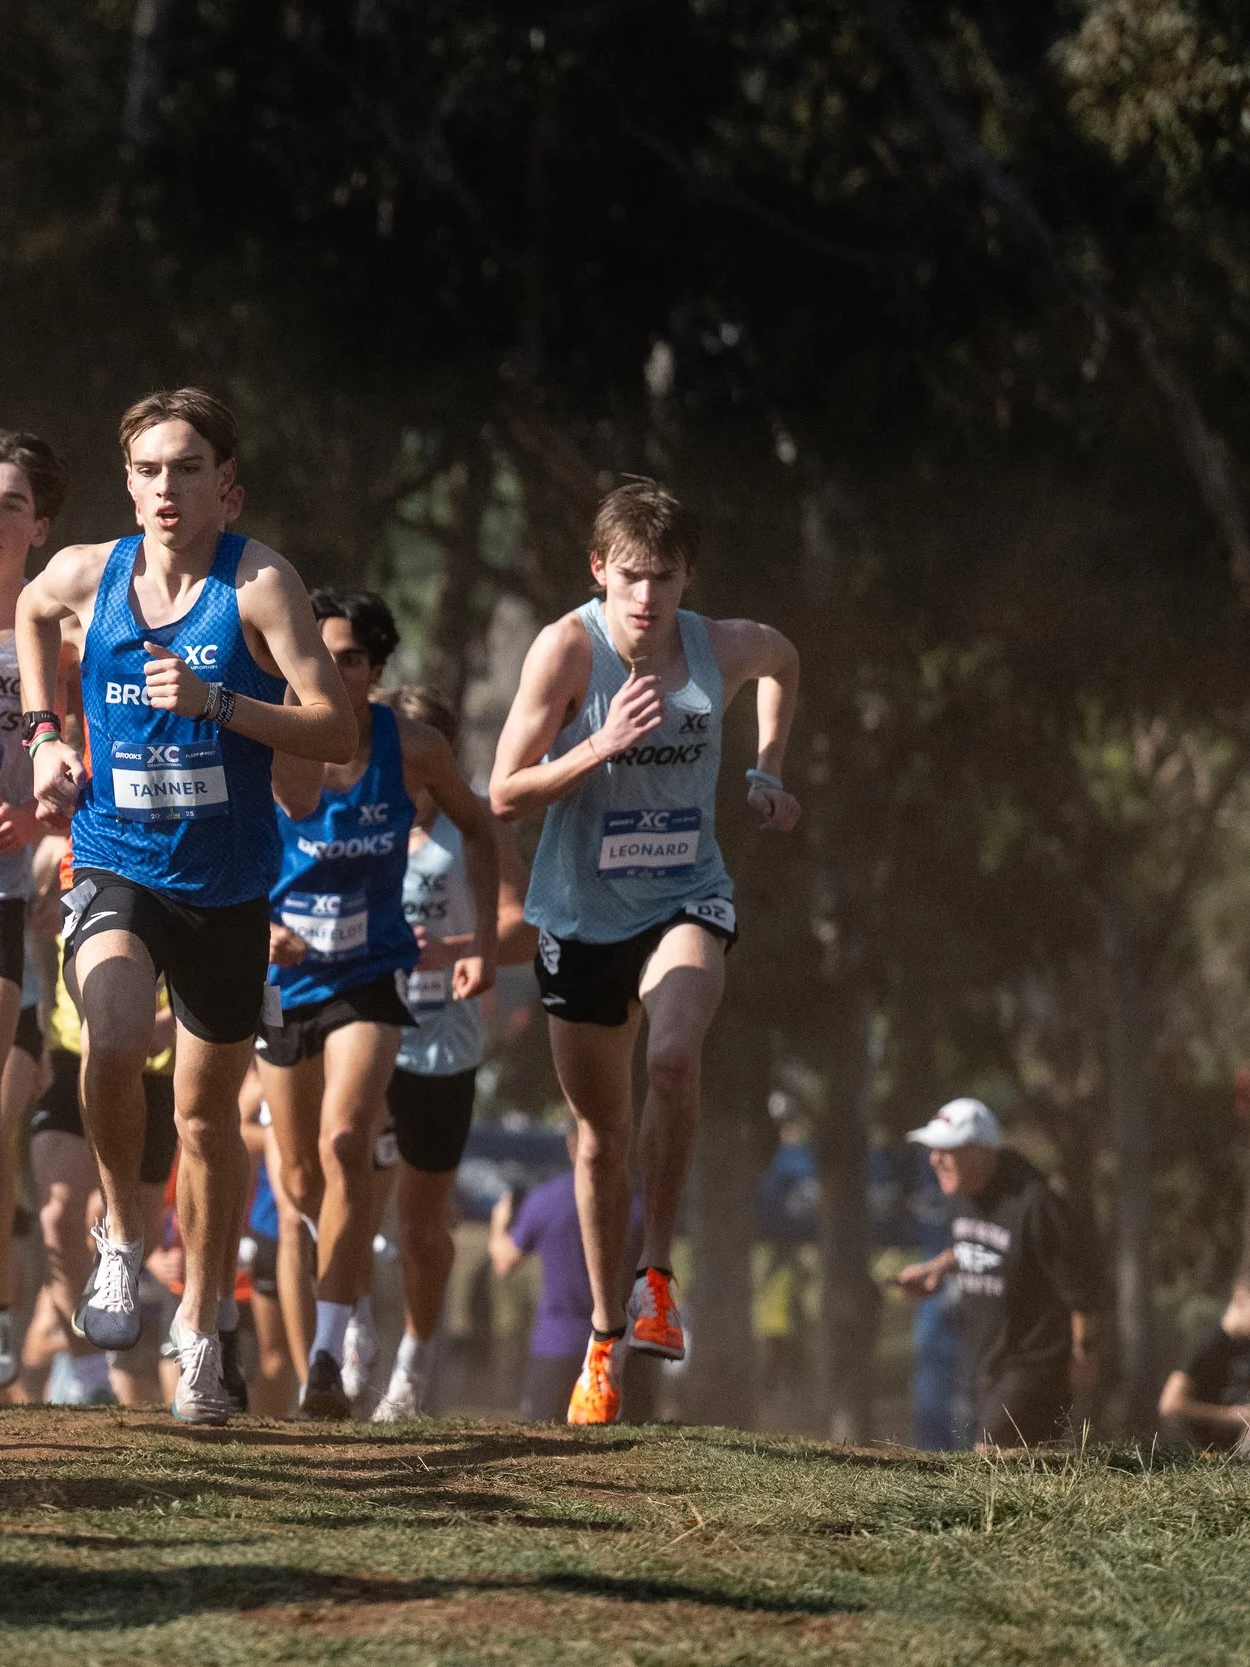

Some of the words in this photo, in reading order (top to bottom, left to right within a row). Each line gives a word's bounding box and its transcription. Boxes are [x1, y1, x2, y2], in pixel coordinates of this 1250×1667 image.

[183, 644, 218, 665] XC
[680, 713, 710, 732] XC
[115, 752, 142, 760] BROOKS
[146, 746, 180, 763] XC
[130, 781, 208, 797] TANNER
[358, 803, 389, 823] XC
[638, 810, 670, 828] XC
[297, 832, 396, 860] BROOKS
[609, 842, 689, 858] LEONARD
[312, 894, 341, 914] XC
